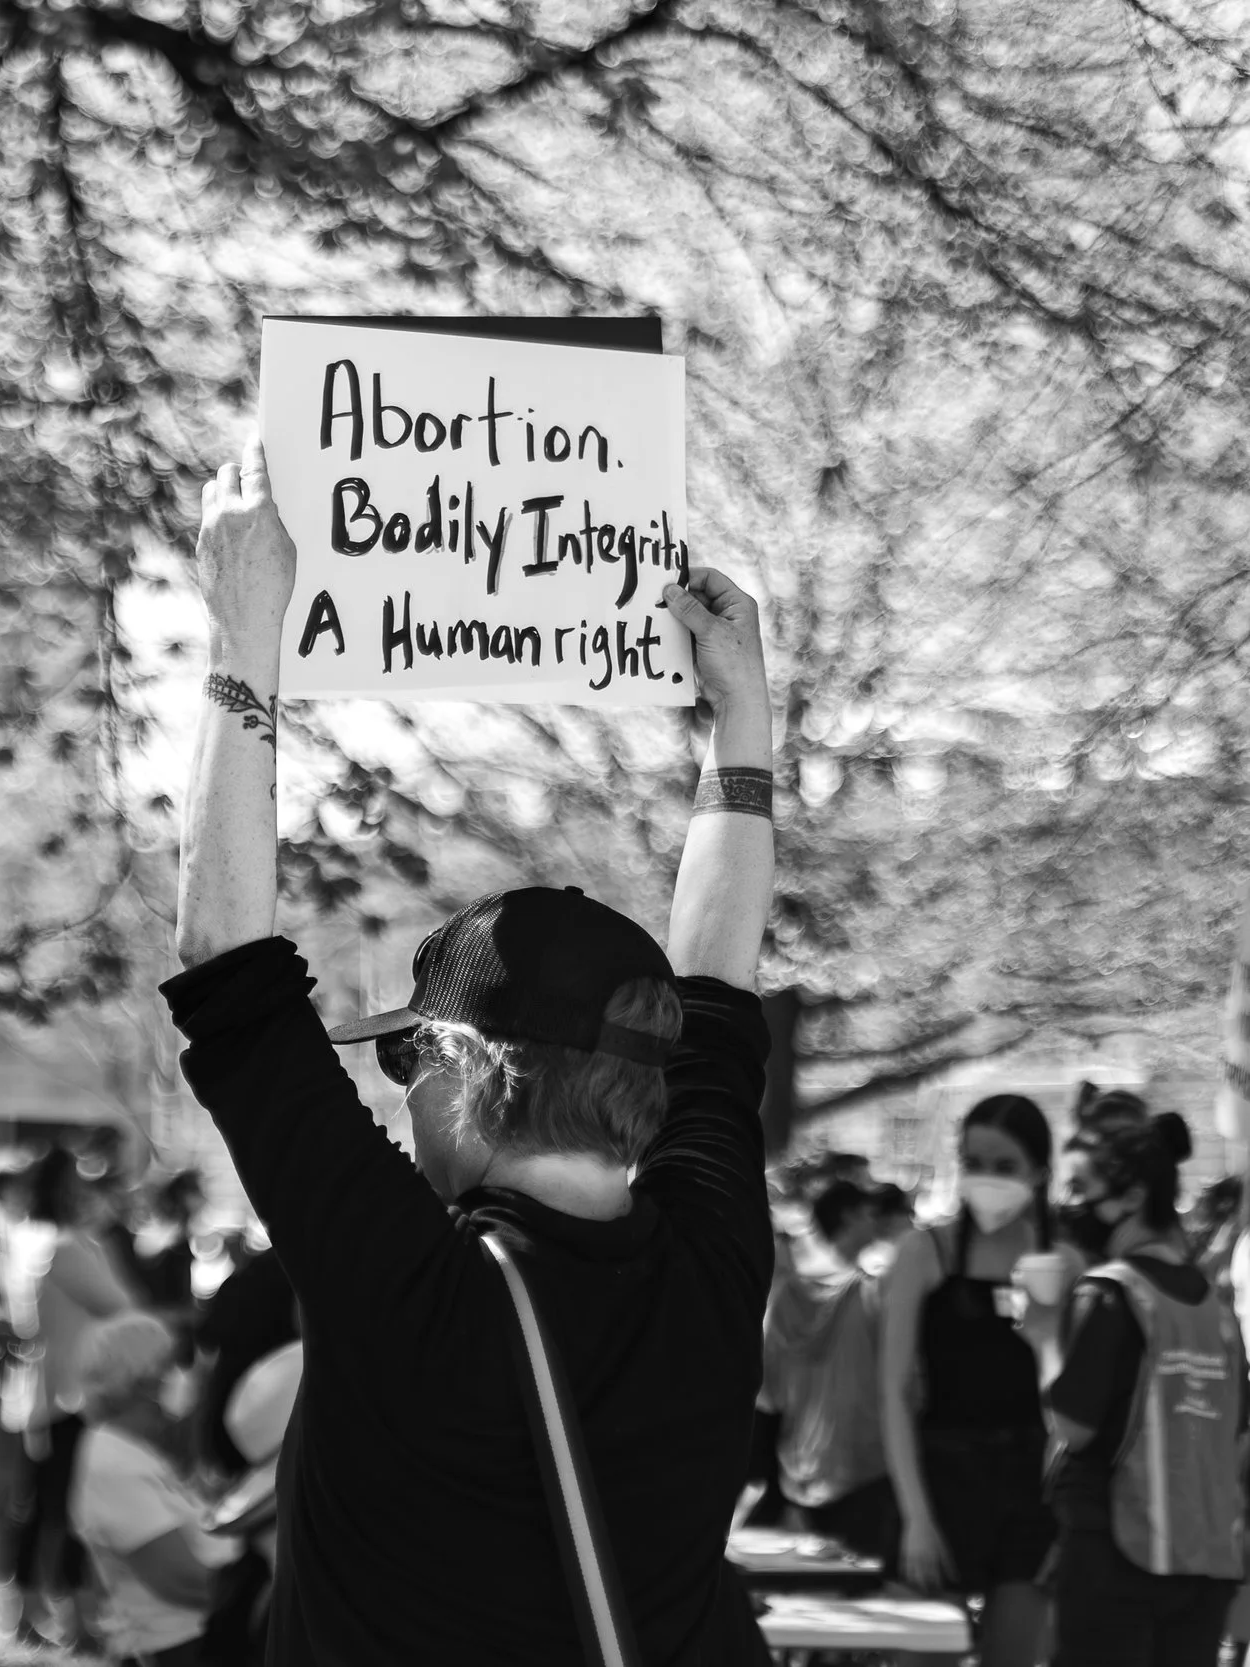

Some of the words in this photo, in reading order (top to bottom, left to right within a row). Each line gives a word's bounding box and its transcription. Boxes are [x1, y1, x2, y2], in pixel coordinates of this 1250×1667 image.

[320, 358, 624, 473] Abortion.
[330, 475, 509, 595] Bodily
[521, 495, 689, 609] Integrity
[298, 590, 346, 658] A
[382, 590, 541, 674] Human
[555, 615, 684, 690] right.
